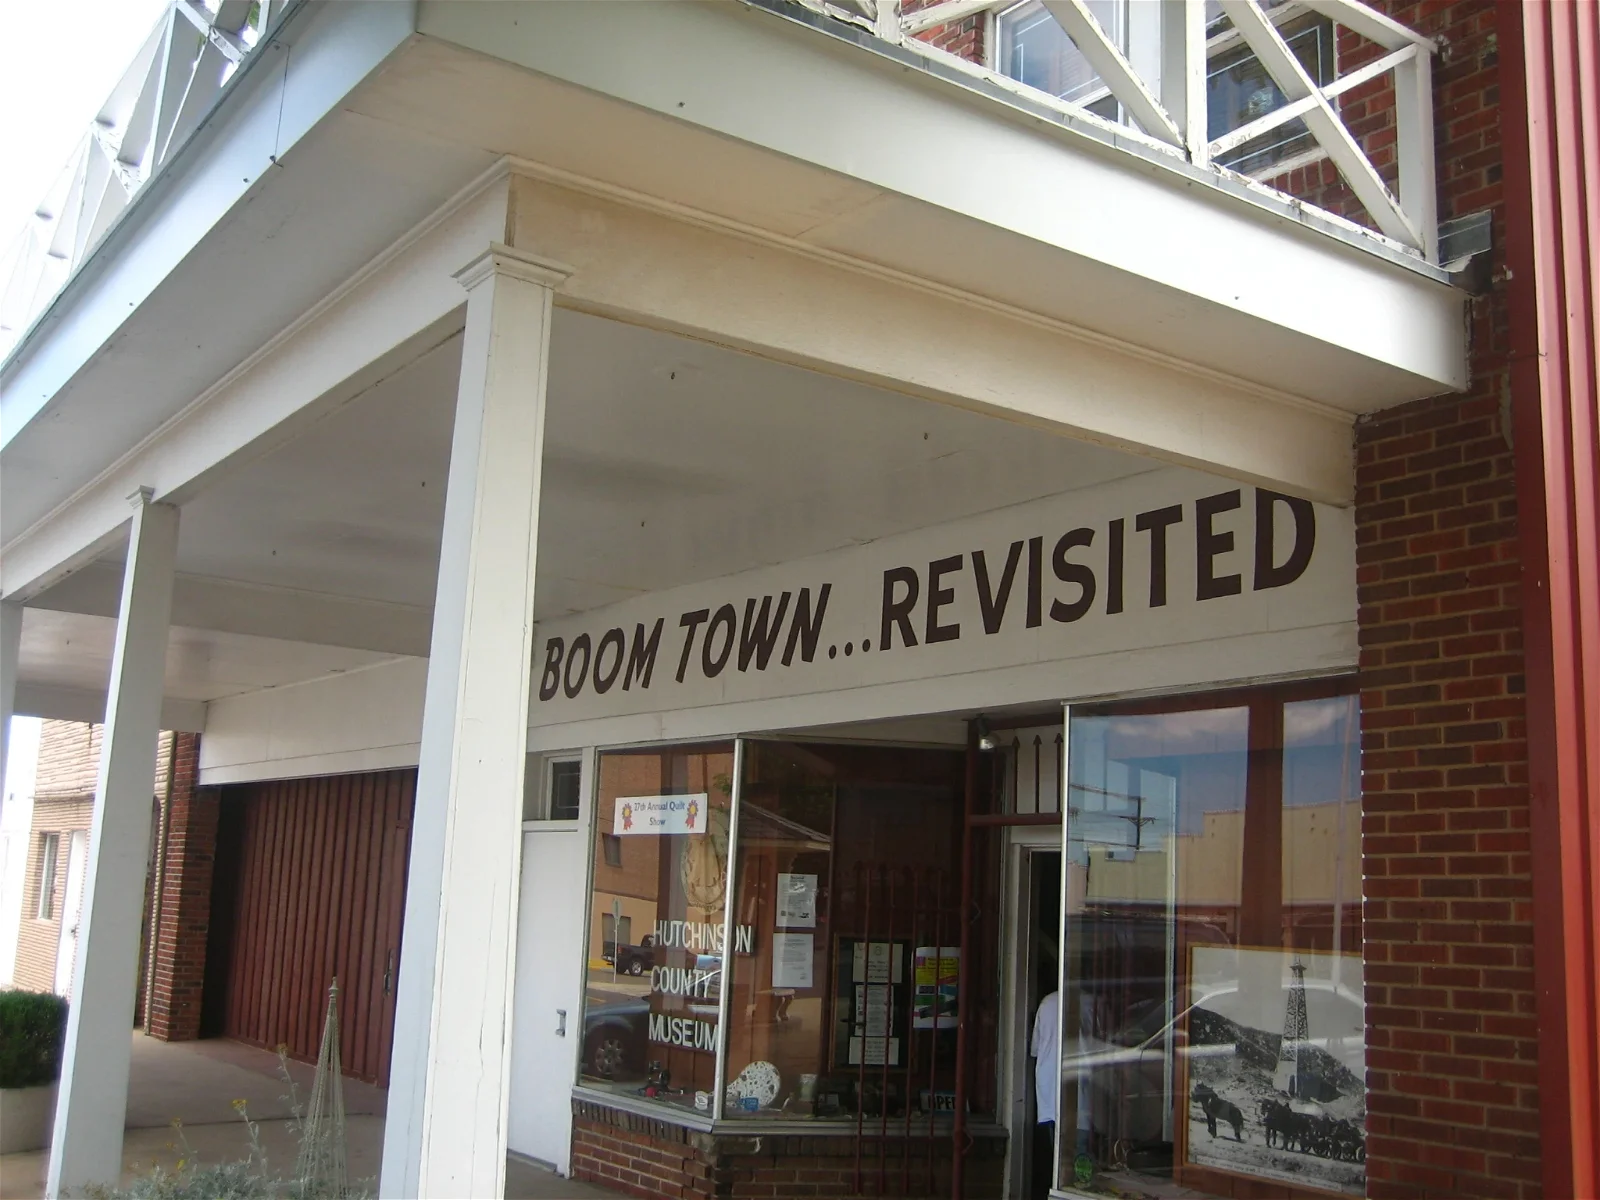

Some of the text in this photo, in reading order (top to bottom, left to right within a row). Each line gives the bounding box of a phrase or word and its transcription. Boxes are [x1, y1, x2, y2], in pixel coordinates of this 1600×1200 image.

[538, 617, 664, 701] BOOM
[633, 801, 686, 812] 27th Annual Quilt
[649, 816, 667, 826] Show
[650, 965, 713, 998] COUNTY
[648, 1012, 719, 1052] MUSEUM
